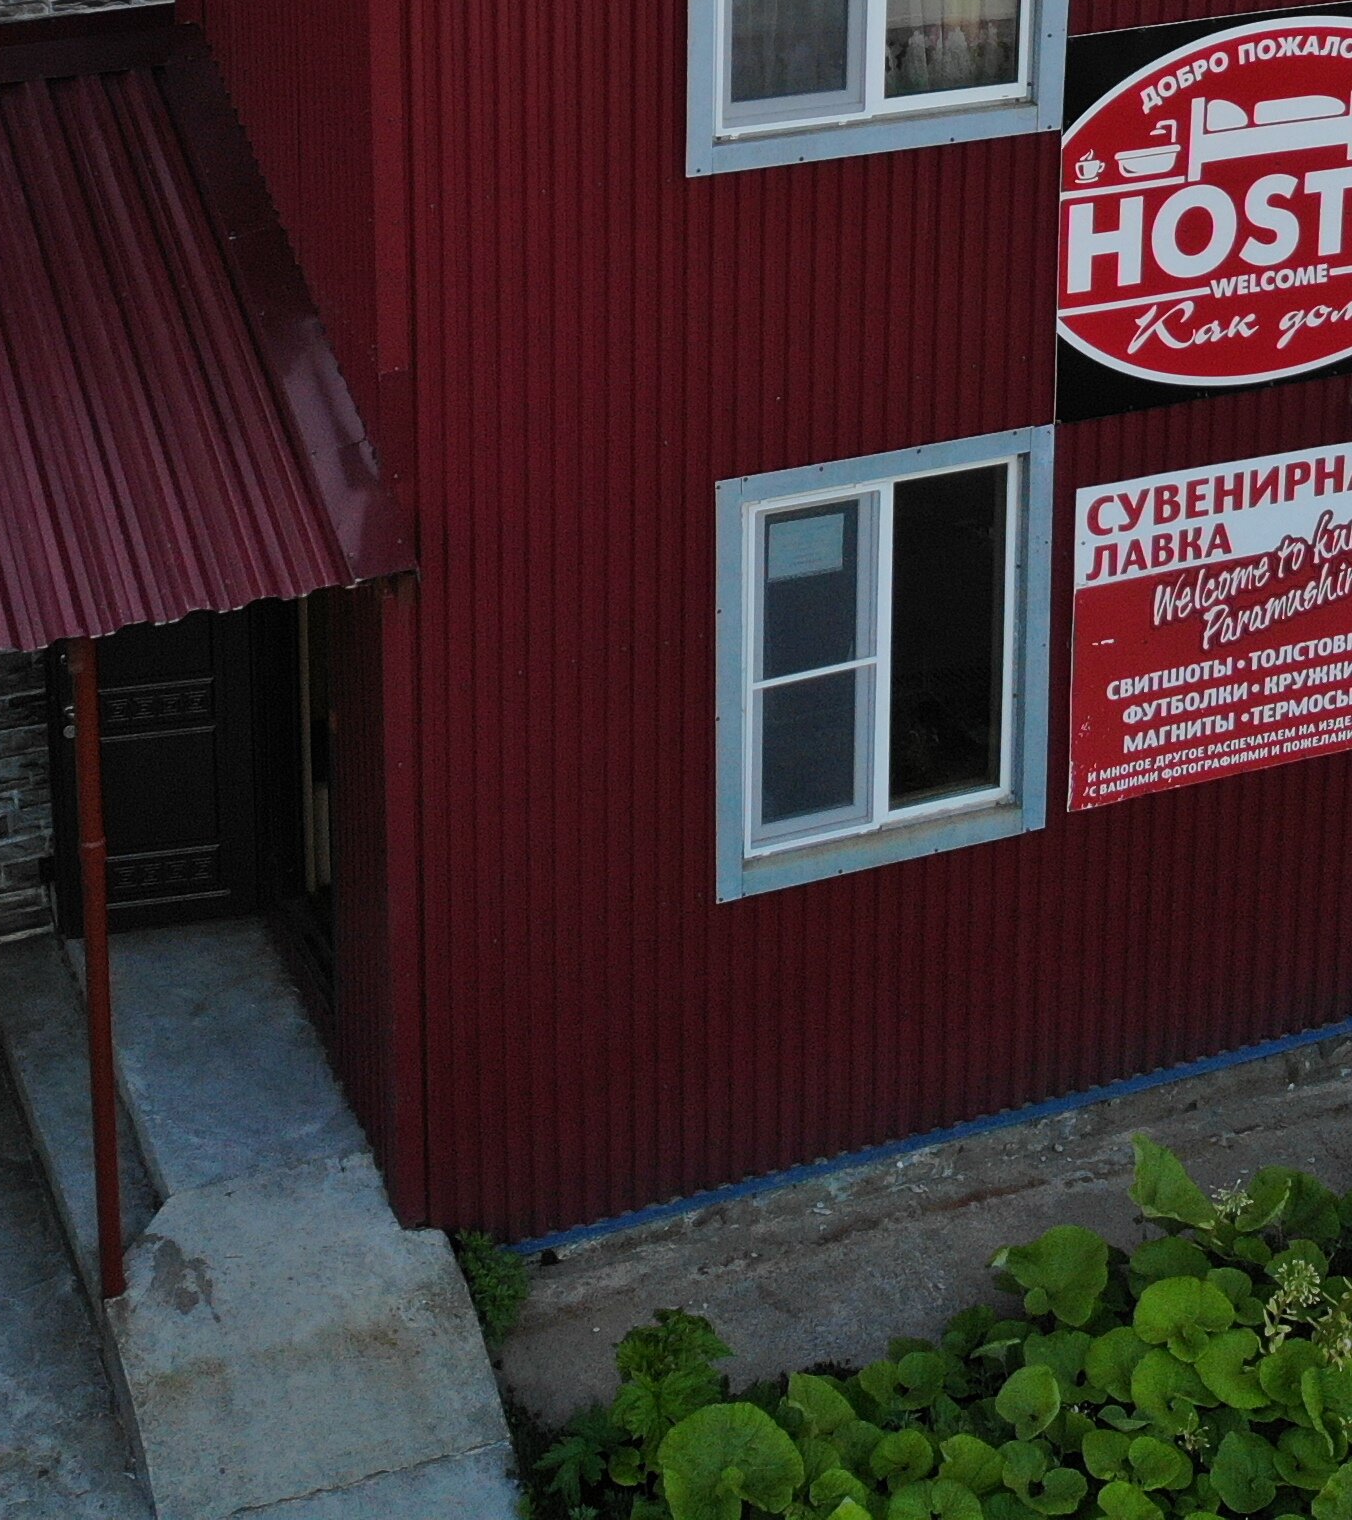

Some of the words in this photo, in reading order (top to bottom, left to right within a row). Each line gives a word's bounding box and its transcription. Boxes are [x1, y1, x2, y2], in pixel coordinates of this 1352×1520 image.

[1139, 52, 1229, 114] ДОБРО
[1210, 263, 1328, 298] WELCOME
[1127, 301, 1260, 355] Как
[1085, 522, 1233, 581] ЛАВКА
[1153, 557, 1271, 626] Welcome
[1277, 538, 1305, 578] to
[1106, 656, 1233, 701] СВИТШОТЫ
[1122, 682, 1248, 724] ФУТБОЛКИ
[1087, 772, 1097, 783] И
[1099, 758, 1151, 780] МНОГОЕ
[1154, 746, 1205, 769] ДРУГОЕ
[1207, 727, 1296, 755] РАСПЕЧАТАЕМ
[1298, 723, 1316, 736] НА
[1123, 712, 1235, 754] МАГНИТЫ
[1089, 785, 1097, 797] С
[1099, 770, 1159, 795] ВАШИМИ
[1161, 746, 1268, 779] ФОТОГРАФИЯМИ
[1271, 745, 1280, 756] И
